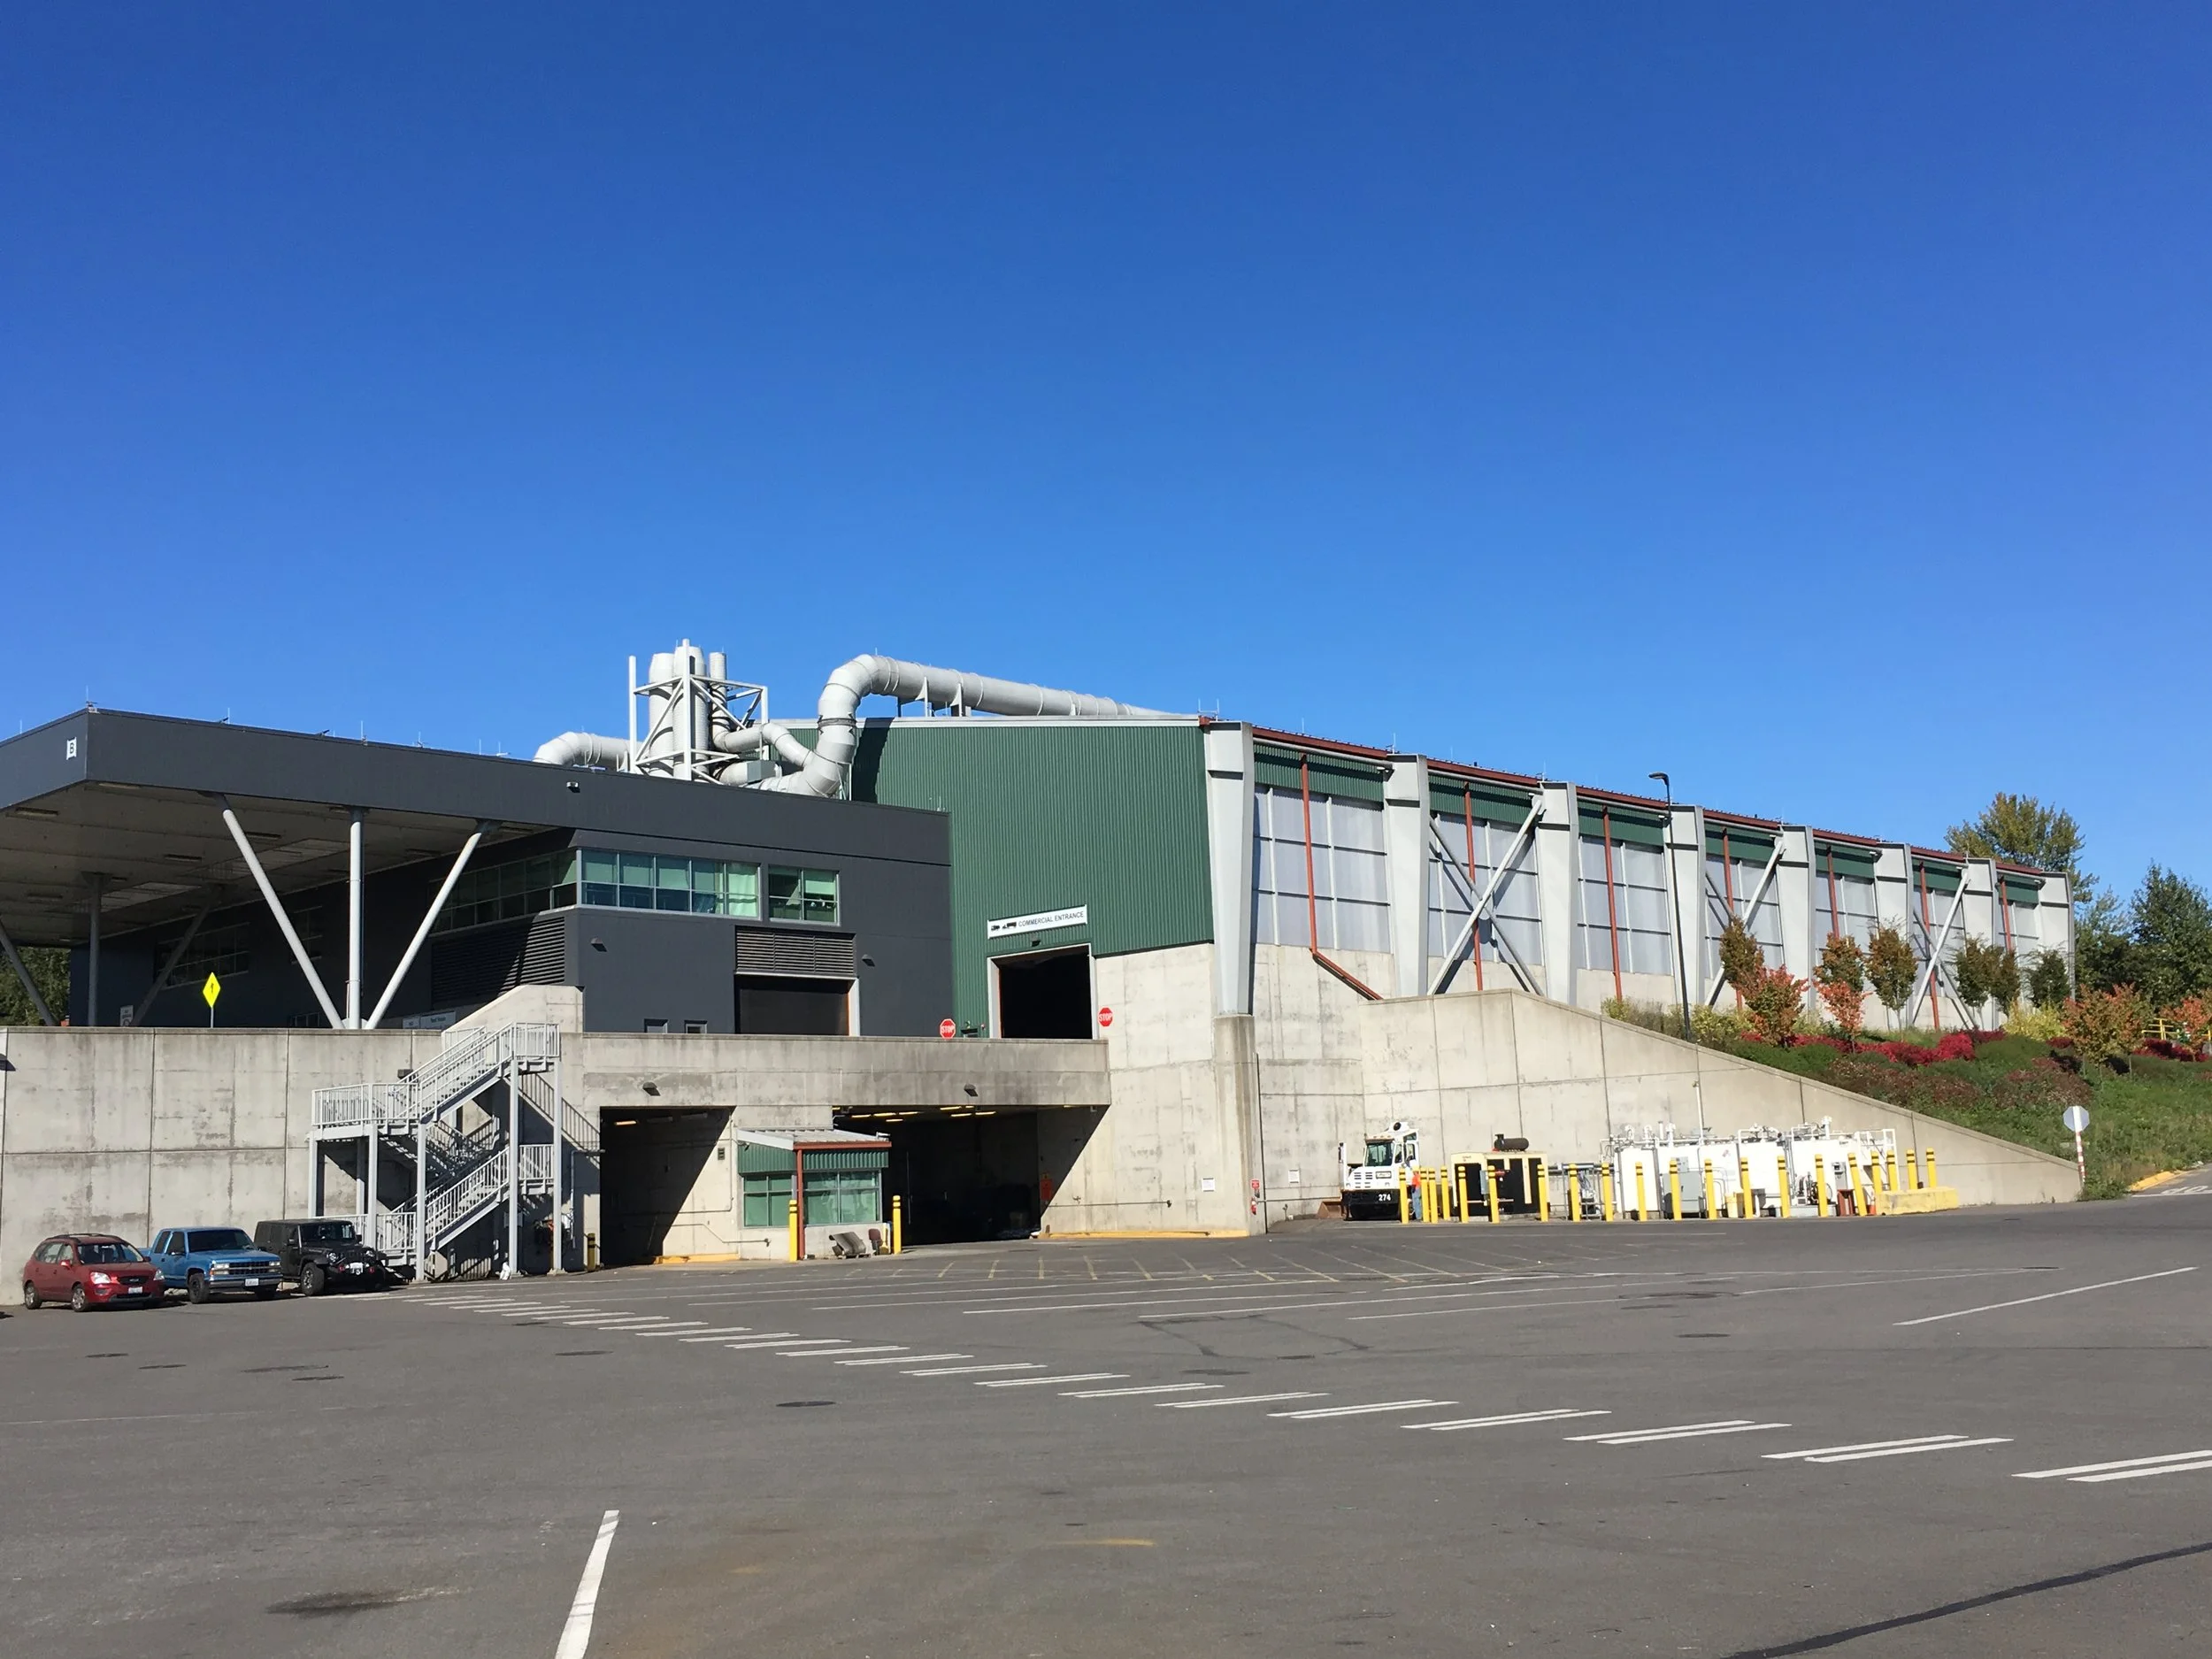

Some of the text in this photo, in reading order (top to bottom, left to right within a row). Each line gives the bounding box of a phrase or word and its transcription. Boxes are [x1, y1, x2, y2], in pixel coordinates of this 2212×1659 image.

[1018, 910, 1084, 927] COMMERCIAL ENTRANCE
[1098, 1013, 1113, 1022] STOP
[941, 1025, 956, 1034] STOP
